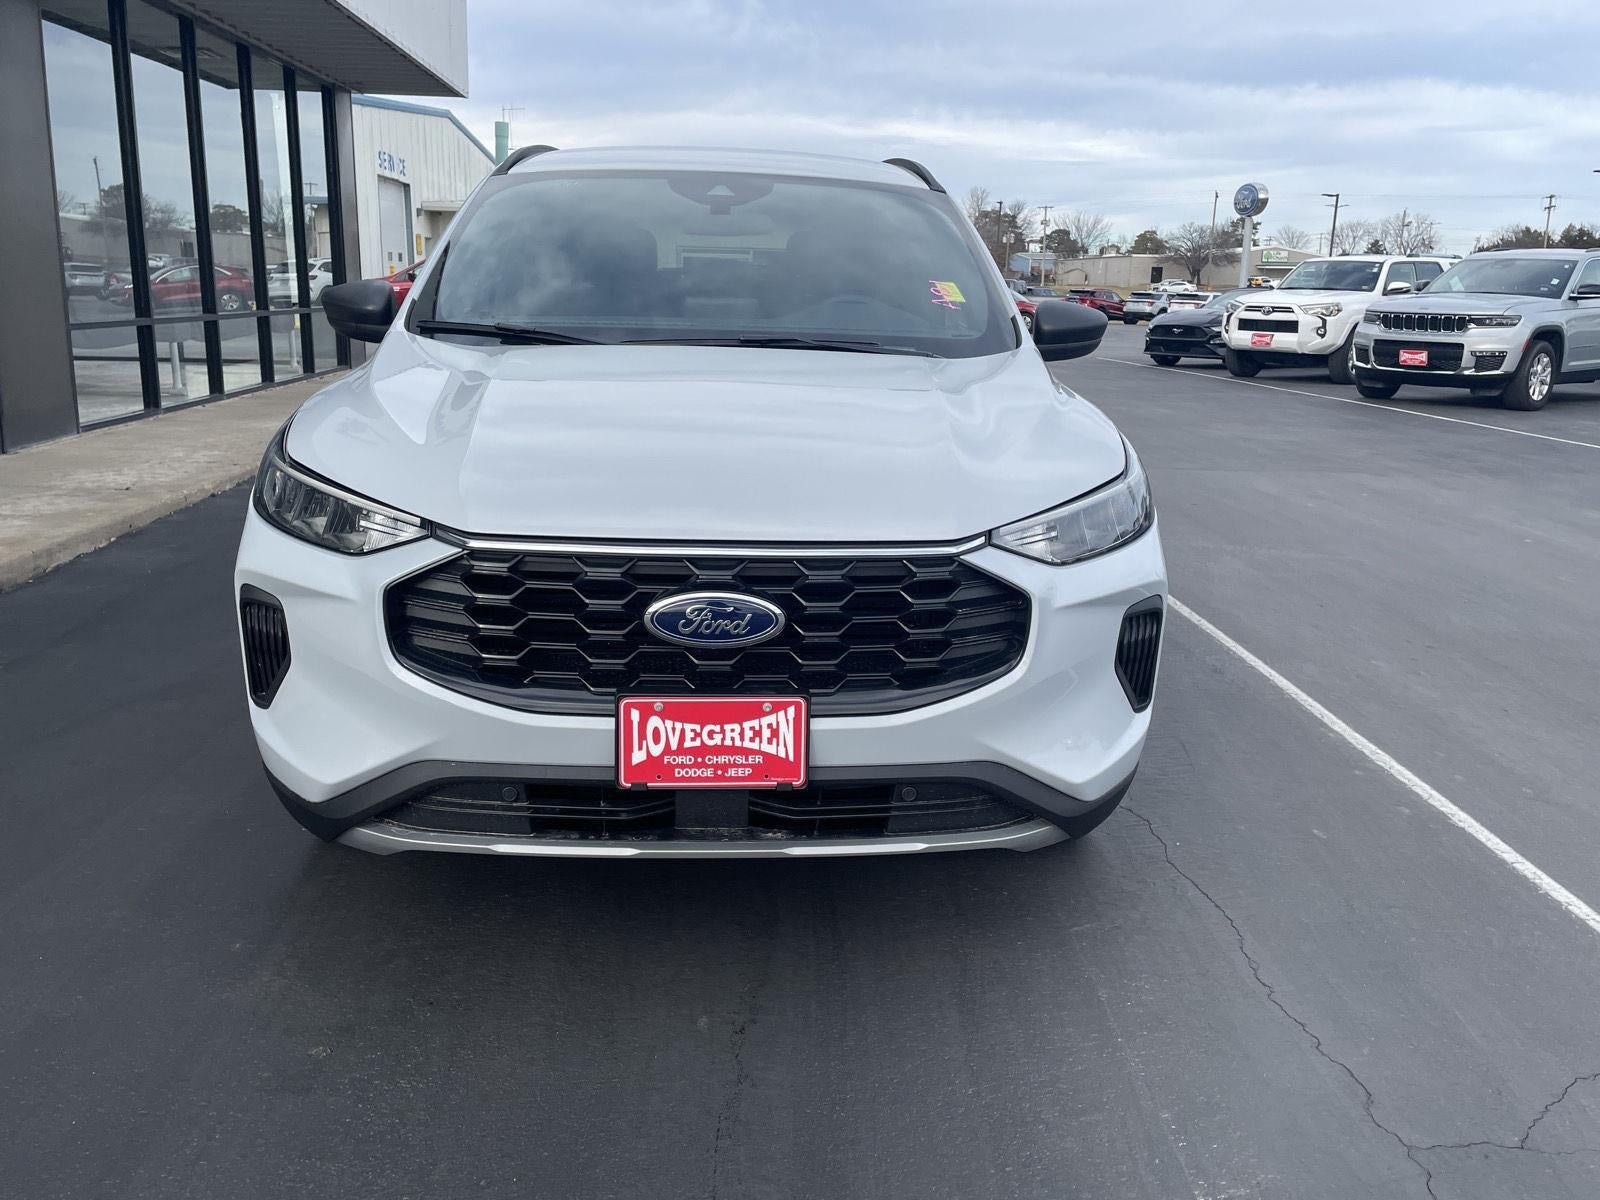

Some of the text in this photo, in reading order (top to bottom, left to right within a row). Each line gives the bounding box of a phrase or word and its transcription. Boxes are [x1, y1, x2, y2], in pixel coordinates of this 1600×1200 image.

[378, 150, 406, 176] SERVCE
[678, 604, 753, 635] Ford
[630, 705, 796, 766] LOVEGREEN
[663, 755, 763, 765] FORD CHRYSLER
[674, 767, 753, 777] DODGE JEEP
